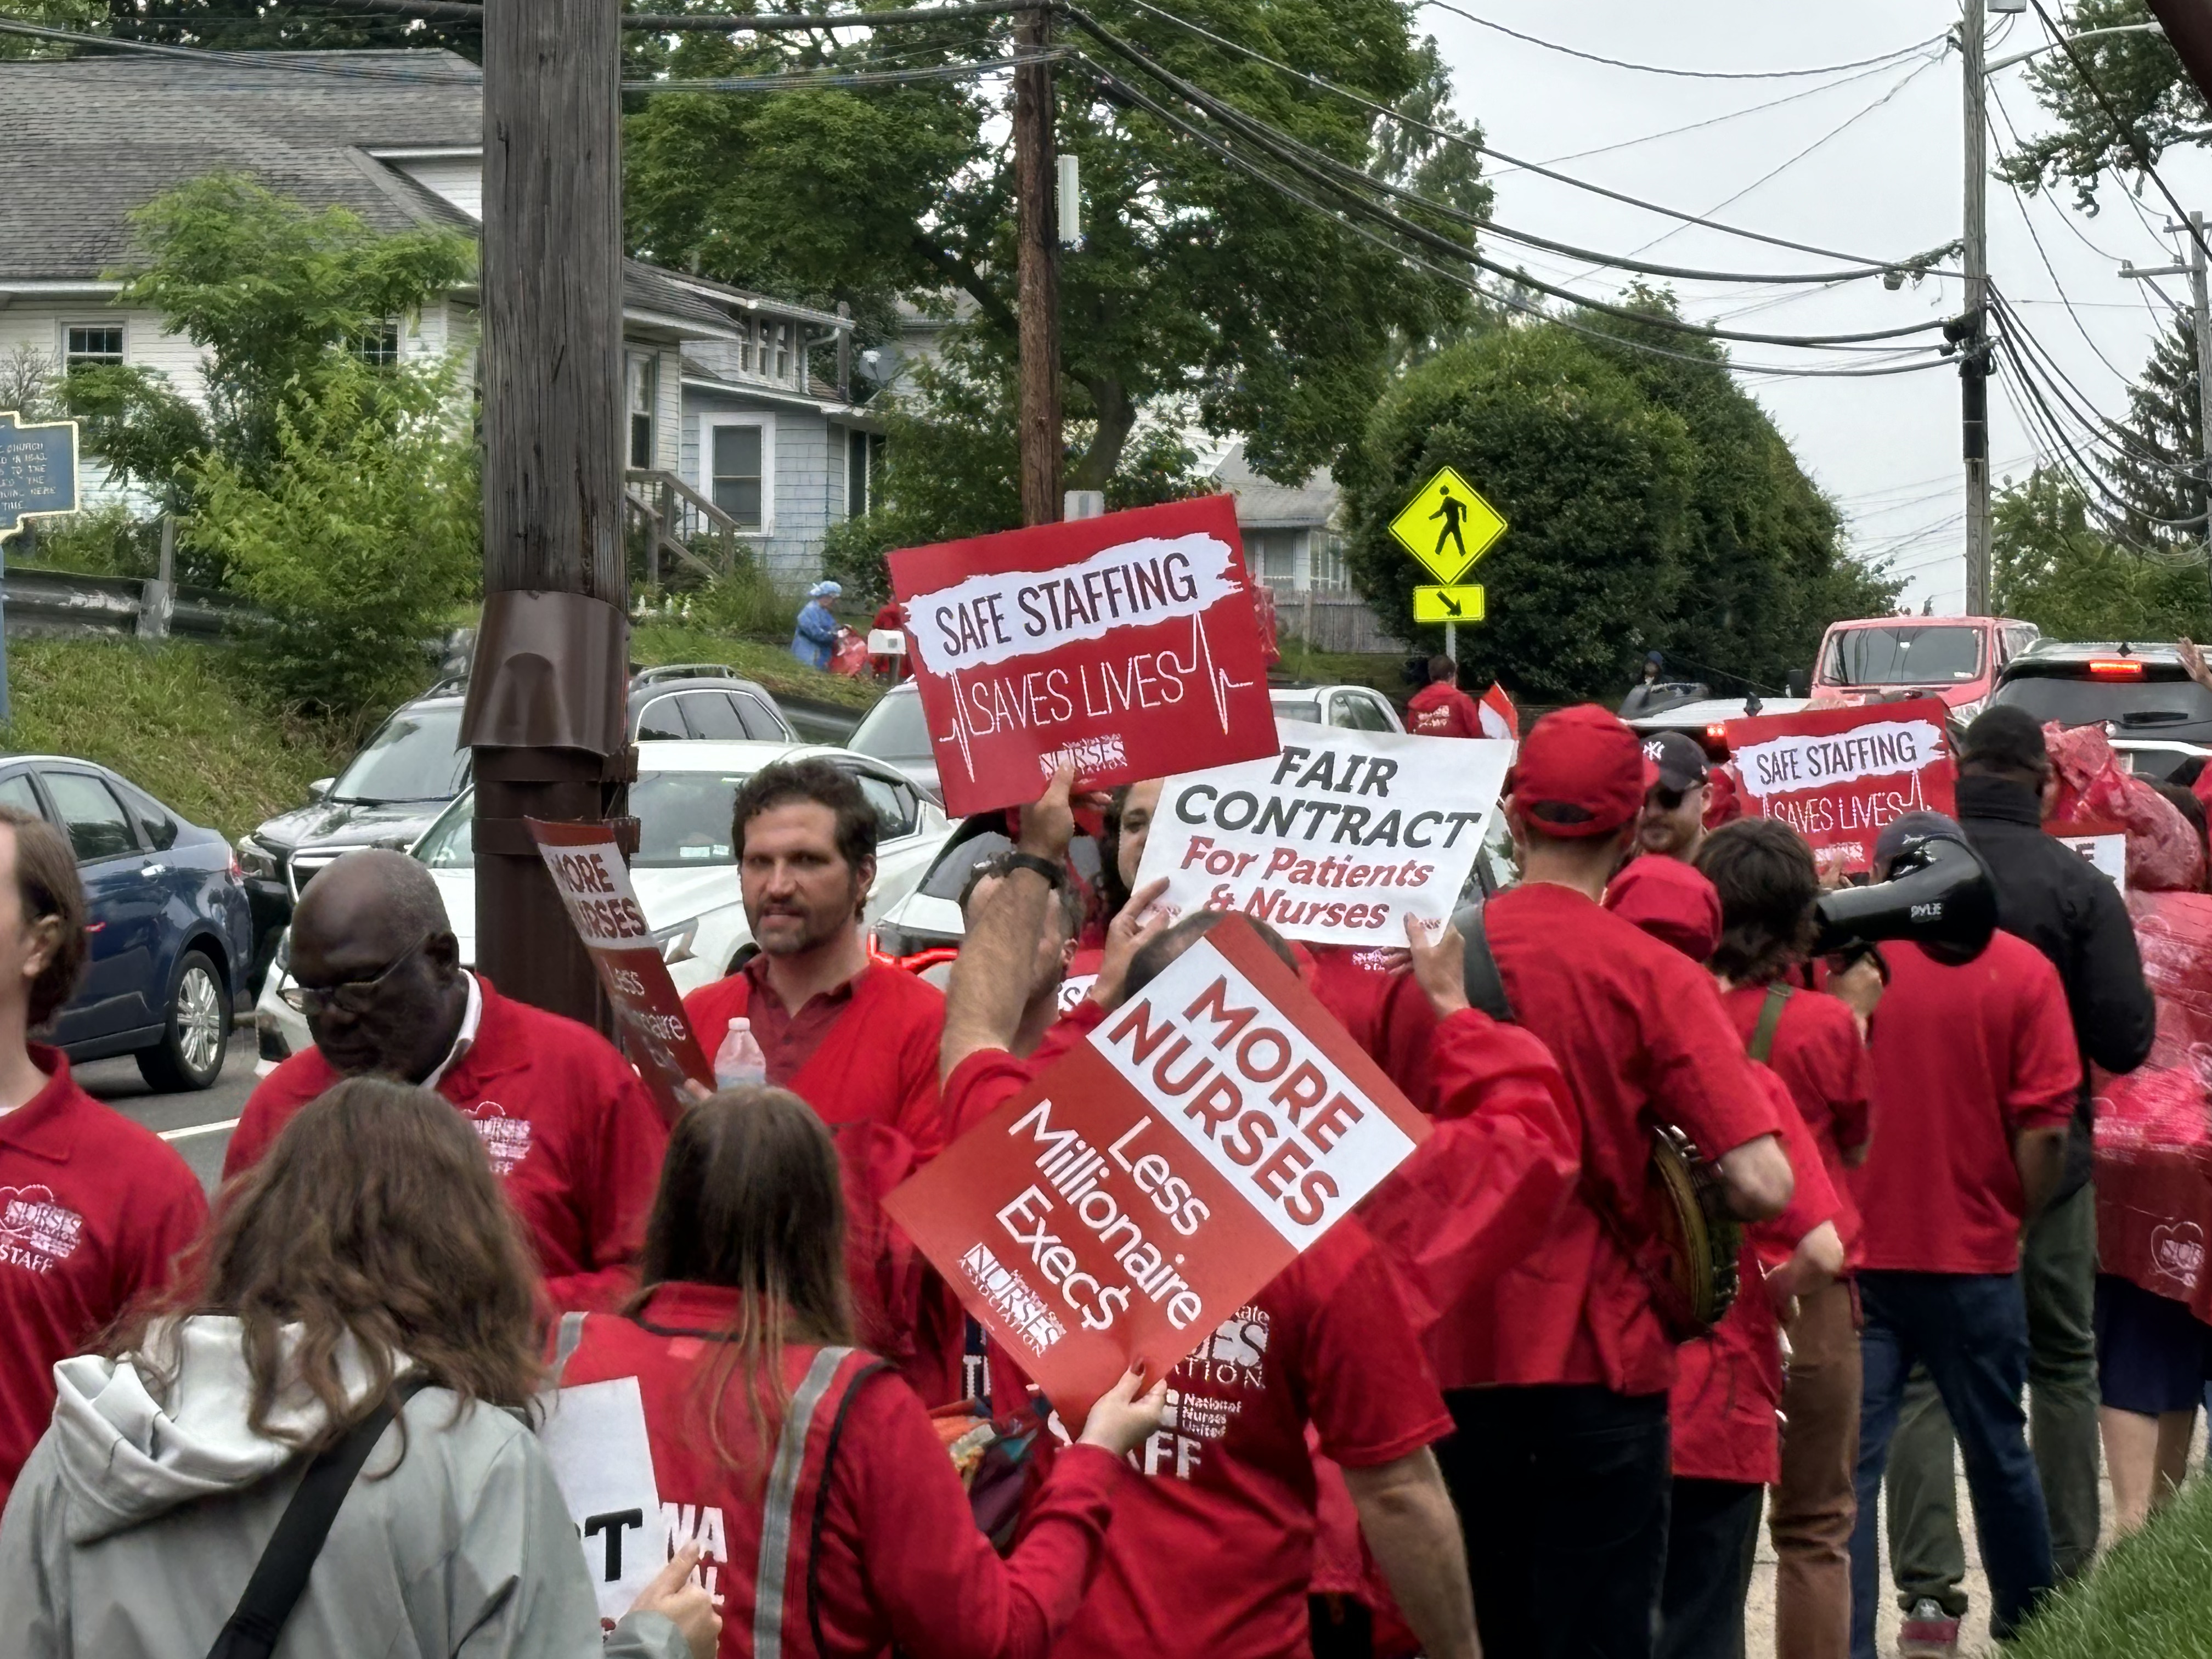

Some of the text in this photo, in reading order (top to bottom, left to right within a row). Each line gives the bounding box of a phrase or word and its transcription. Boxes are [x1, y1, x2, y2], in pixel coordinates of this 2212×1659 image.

[935, 552, 1199, 657] SAFE STAFFING
[971, 651, 1184, 736] SAVES LIVES
[1271, 746, 1398, 798] FAIR
[1757, 731, 1917, 786] SAFE STAFFING
[1175, 784, 1482, 849] CONTRACT
[1774, 791, 1904, 833] SAVES LIVES
[1181, 835, 1435, 888] For Patients
[1203, 883, 1237, 912] &
[1245, 887, 1390, 929] Nurses
[1182, 974, 1364, 1155] MORE
[1107, 997, 1340, 1226] NURSES
[1107, 1115, 1211, 1236] Less
[1007, 1098, 1203, 1330] Millionaire
[0, 1244, 53, 1273] STAFF
[963, 1242, 1063, 1347] NURSES
